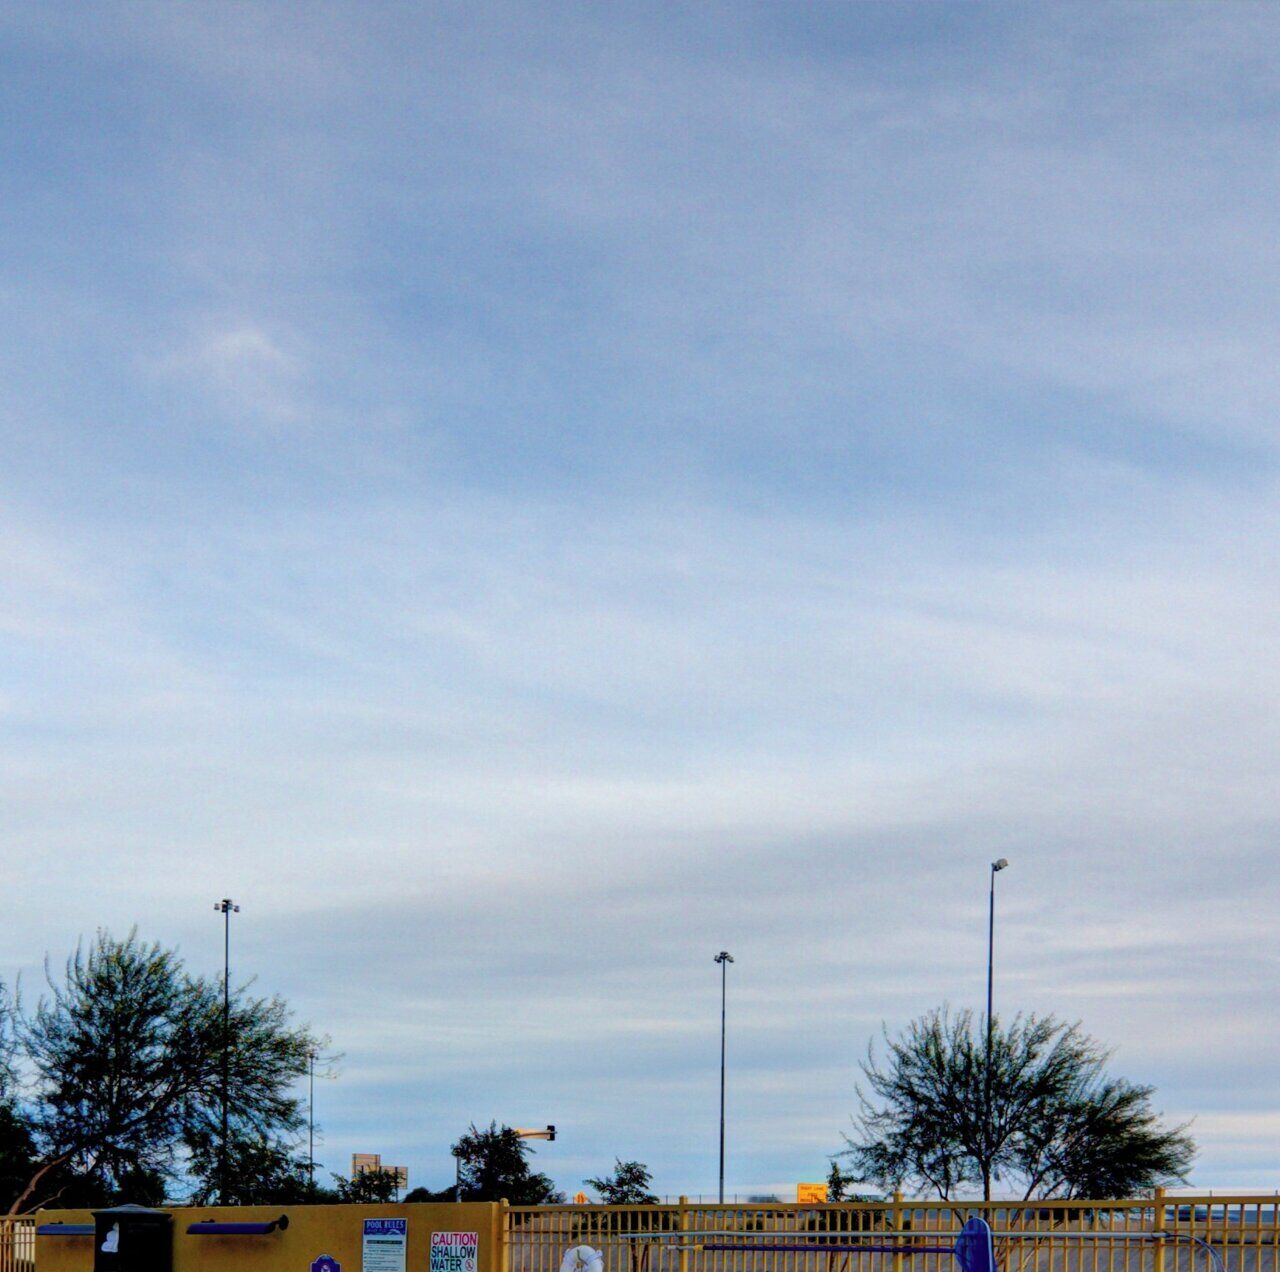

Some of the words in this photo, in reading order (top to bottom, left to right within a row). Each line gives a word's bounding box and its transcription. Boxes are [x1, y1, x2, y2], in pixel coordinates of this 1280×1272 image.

[366, 1220, 382, 1229] POOL
[432, 1233, 477, 1245] CAUTION
[431, 1246, 476, 1258] SHALLOW
[431, 1258, 462, 1271] WATER
